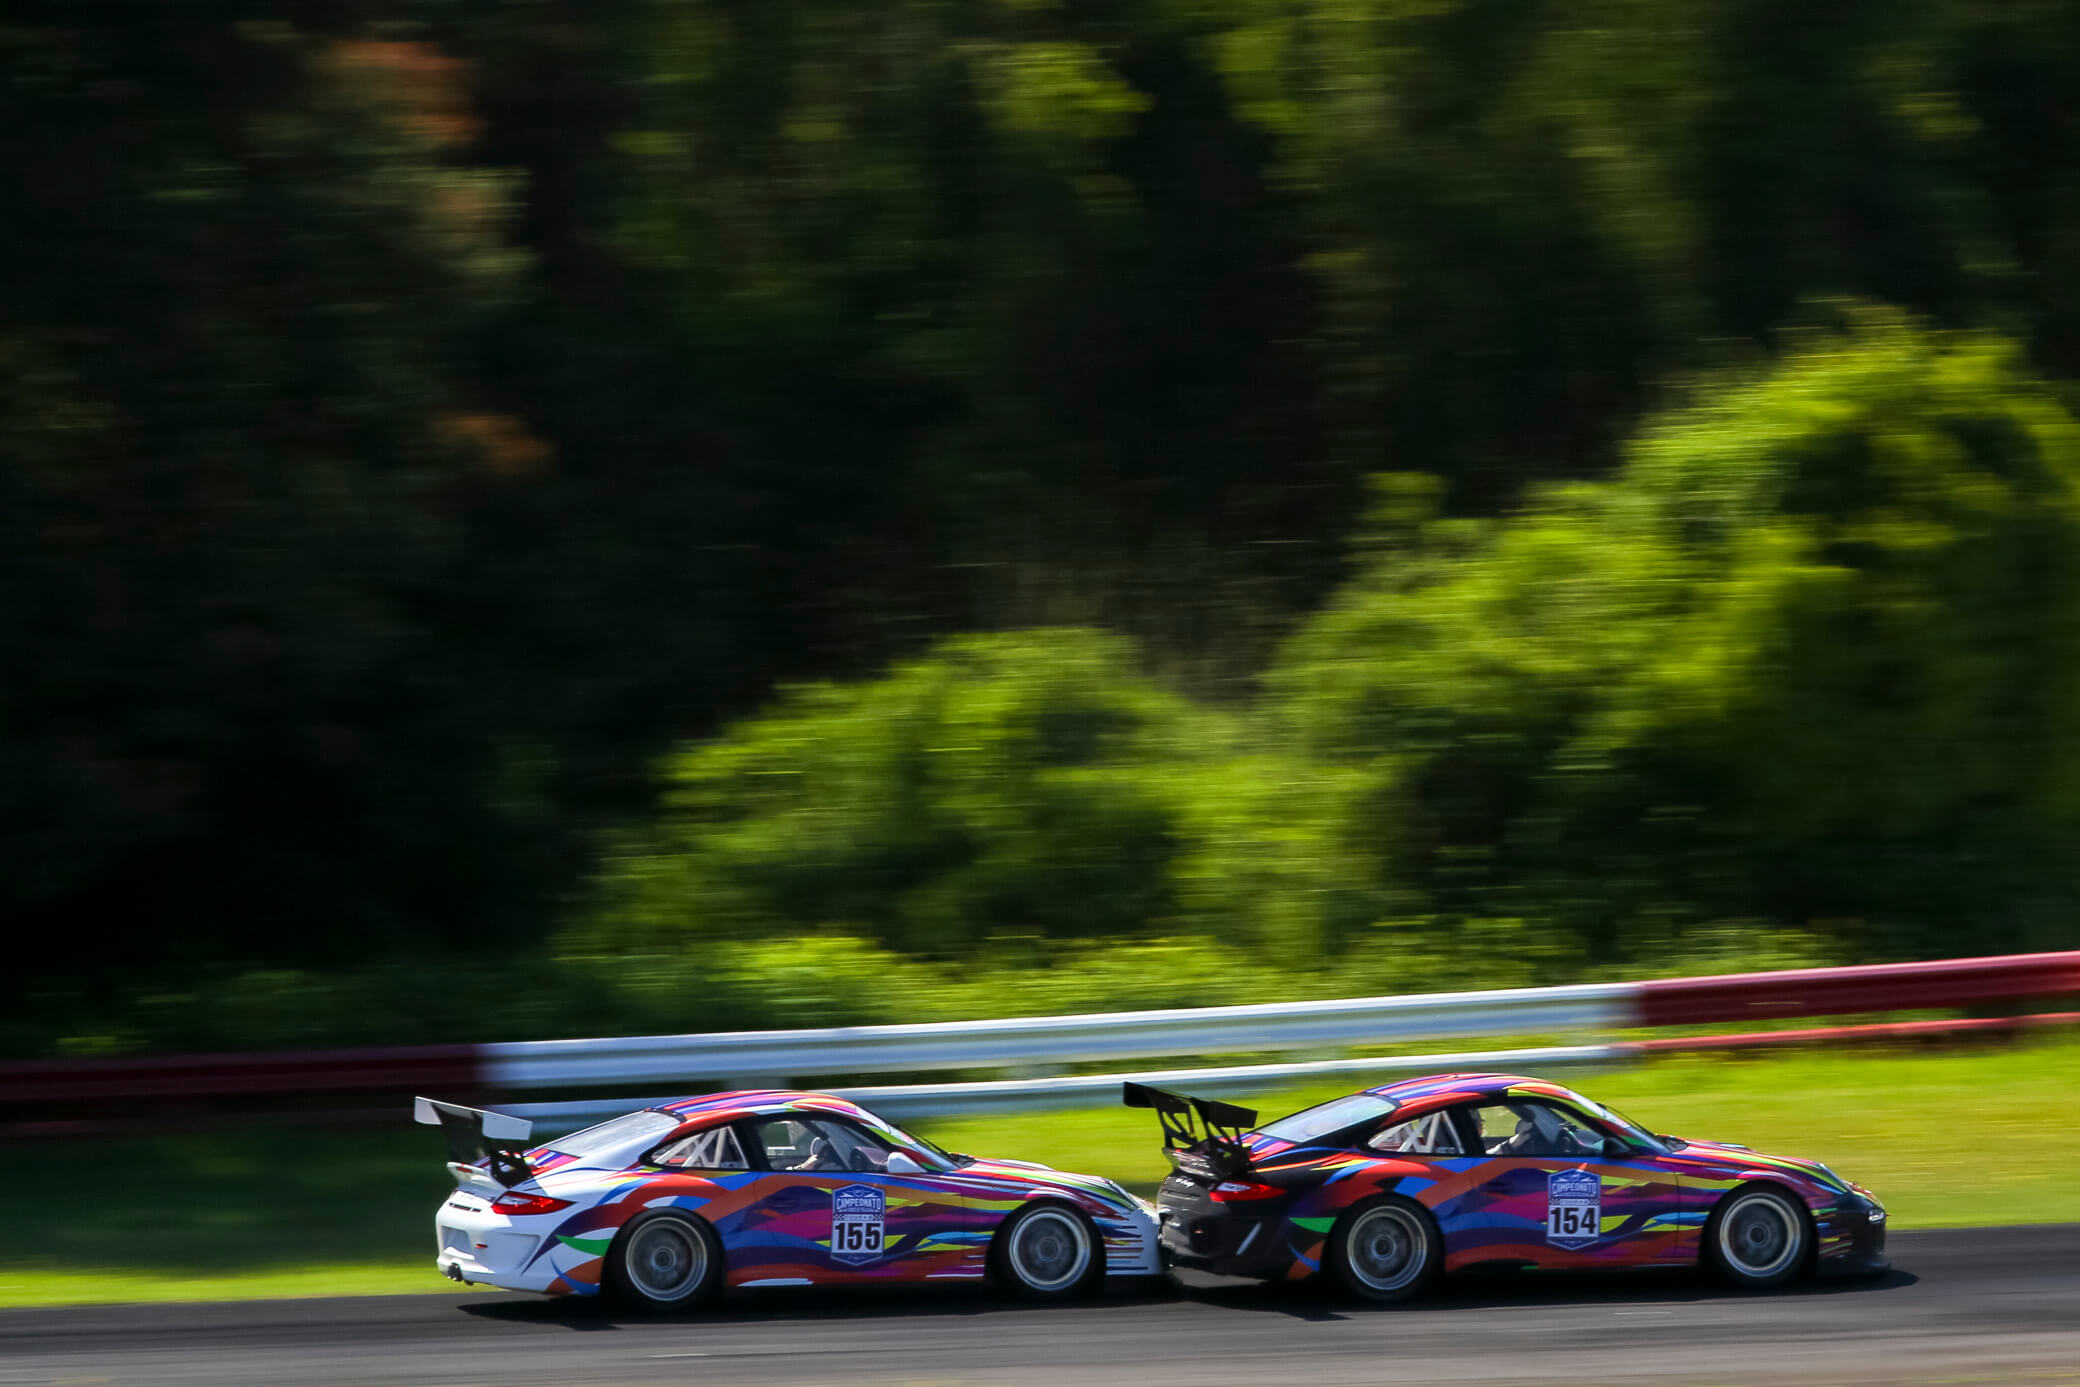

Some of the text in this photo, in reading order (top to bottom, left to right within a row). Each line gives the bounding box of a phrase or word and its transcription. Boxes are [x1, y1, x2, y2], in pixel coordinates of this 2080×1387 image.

[836, 1198, 881, 1210] CAMPEONATO
[1550, 1207, 1596, 1234] 154
[835, 1222, 881, 1250] 155
